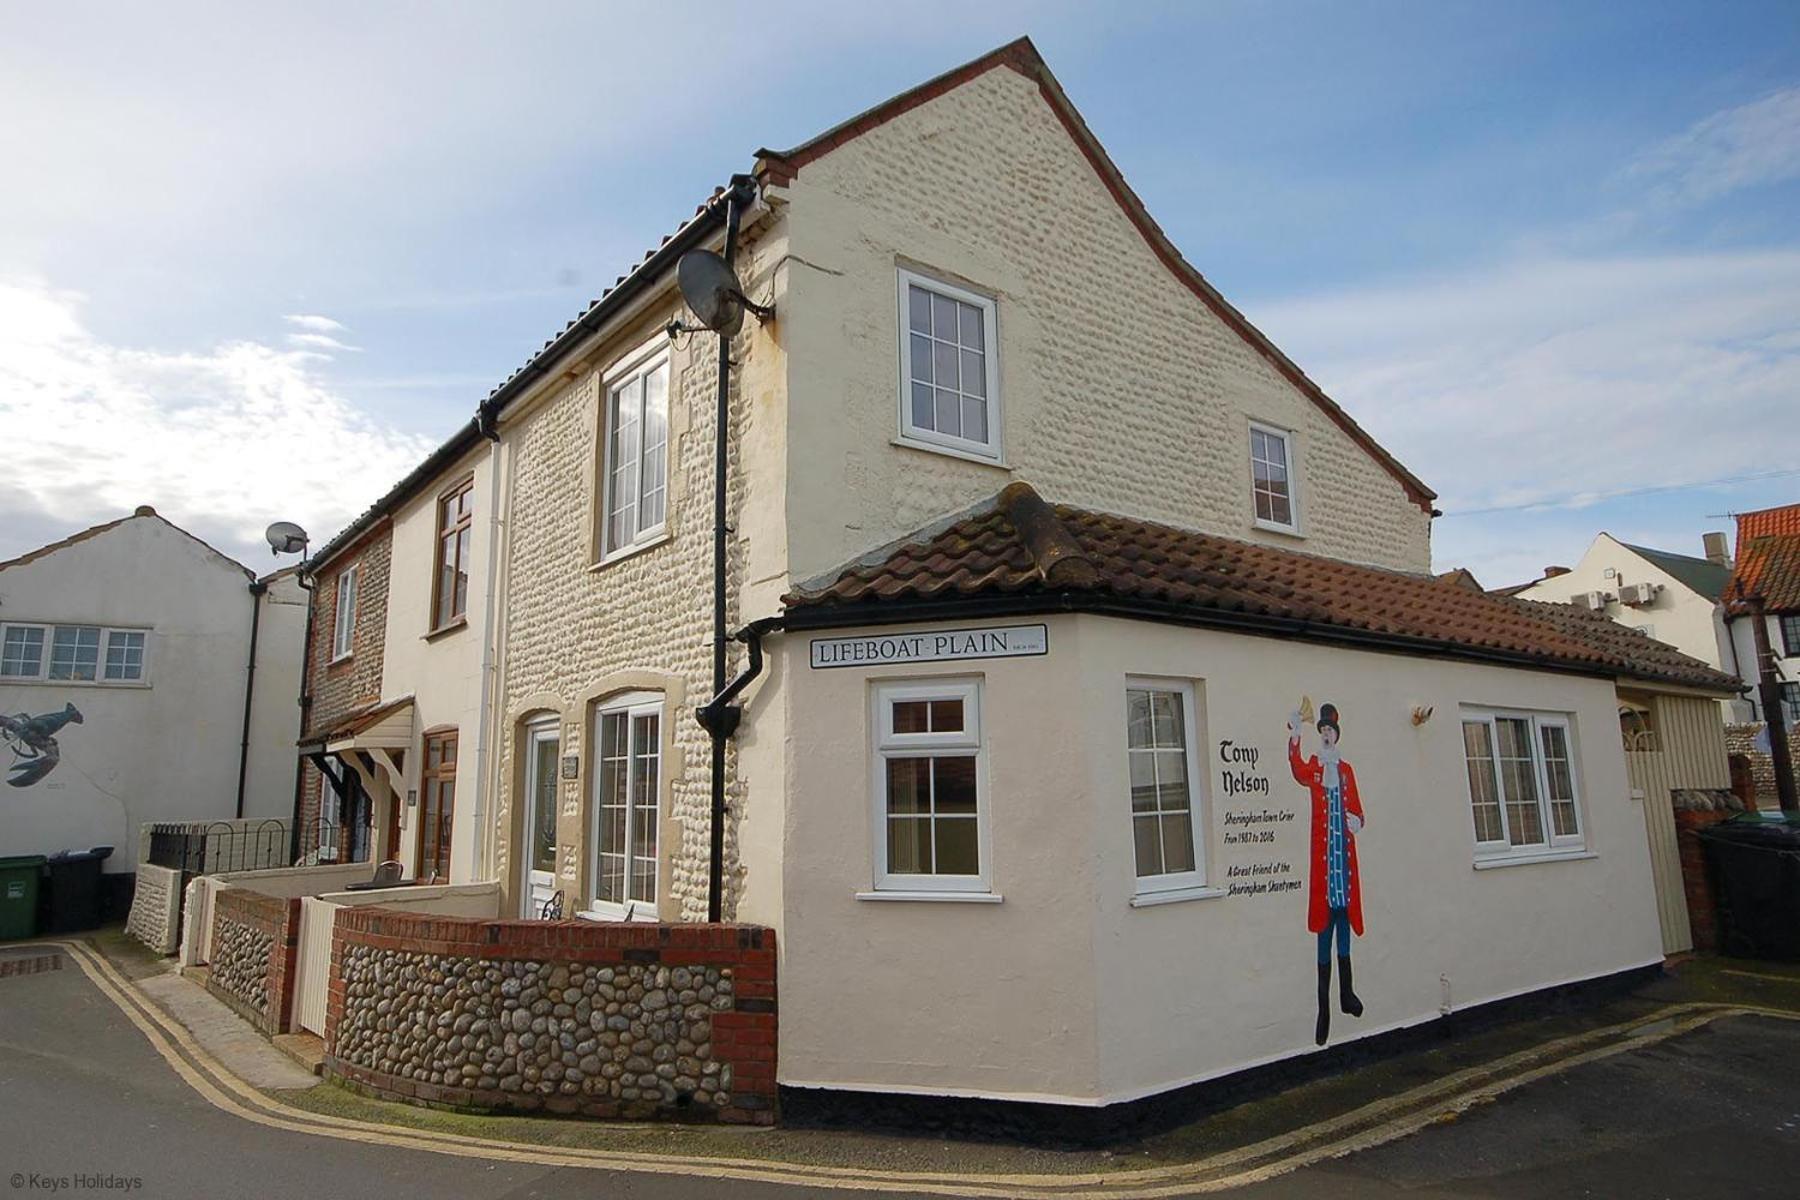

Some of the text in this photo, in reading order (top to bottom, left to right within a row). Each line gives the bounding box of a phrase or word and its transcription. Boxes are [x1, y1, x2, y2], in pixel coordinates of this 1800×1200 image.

[819, 632, 1009, 663] LIFEBOAT PLAIN
[1220, 740, 1259, 770] Tony
[1222, 771, 1269, 797] Nelson
[1224, 811, 1262, 827] Sheringham
[1263, 809, 1278, 822] Town
[1224, 832, 1237, 844] From
[1253, 833, 1259, 843] to
[1227, 862, 1290, 877] A Great Friend of the
[1228, 882, 1267, 897] Sheringham
